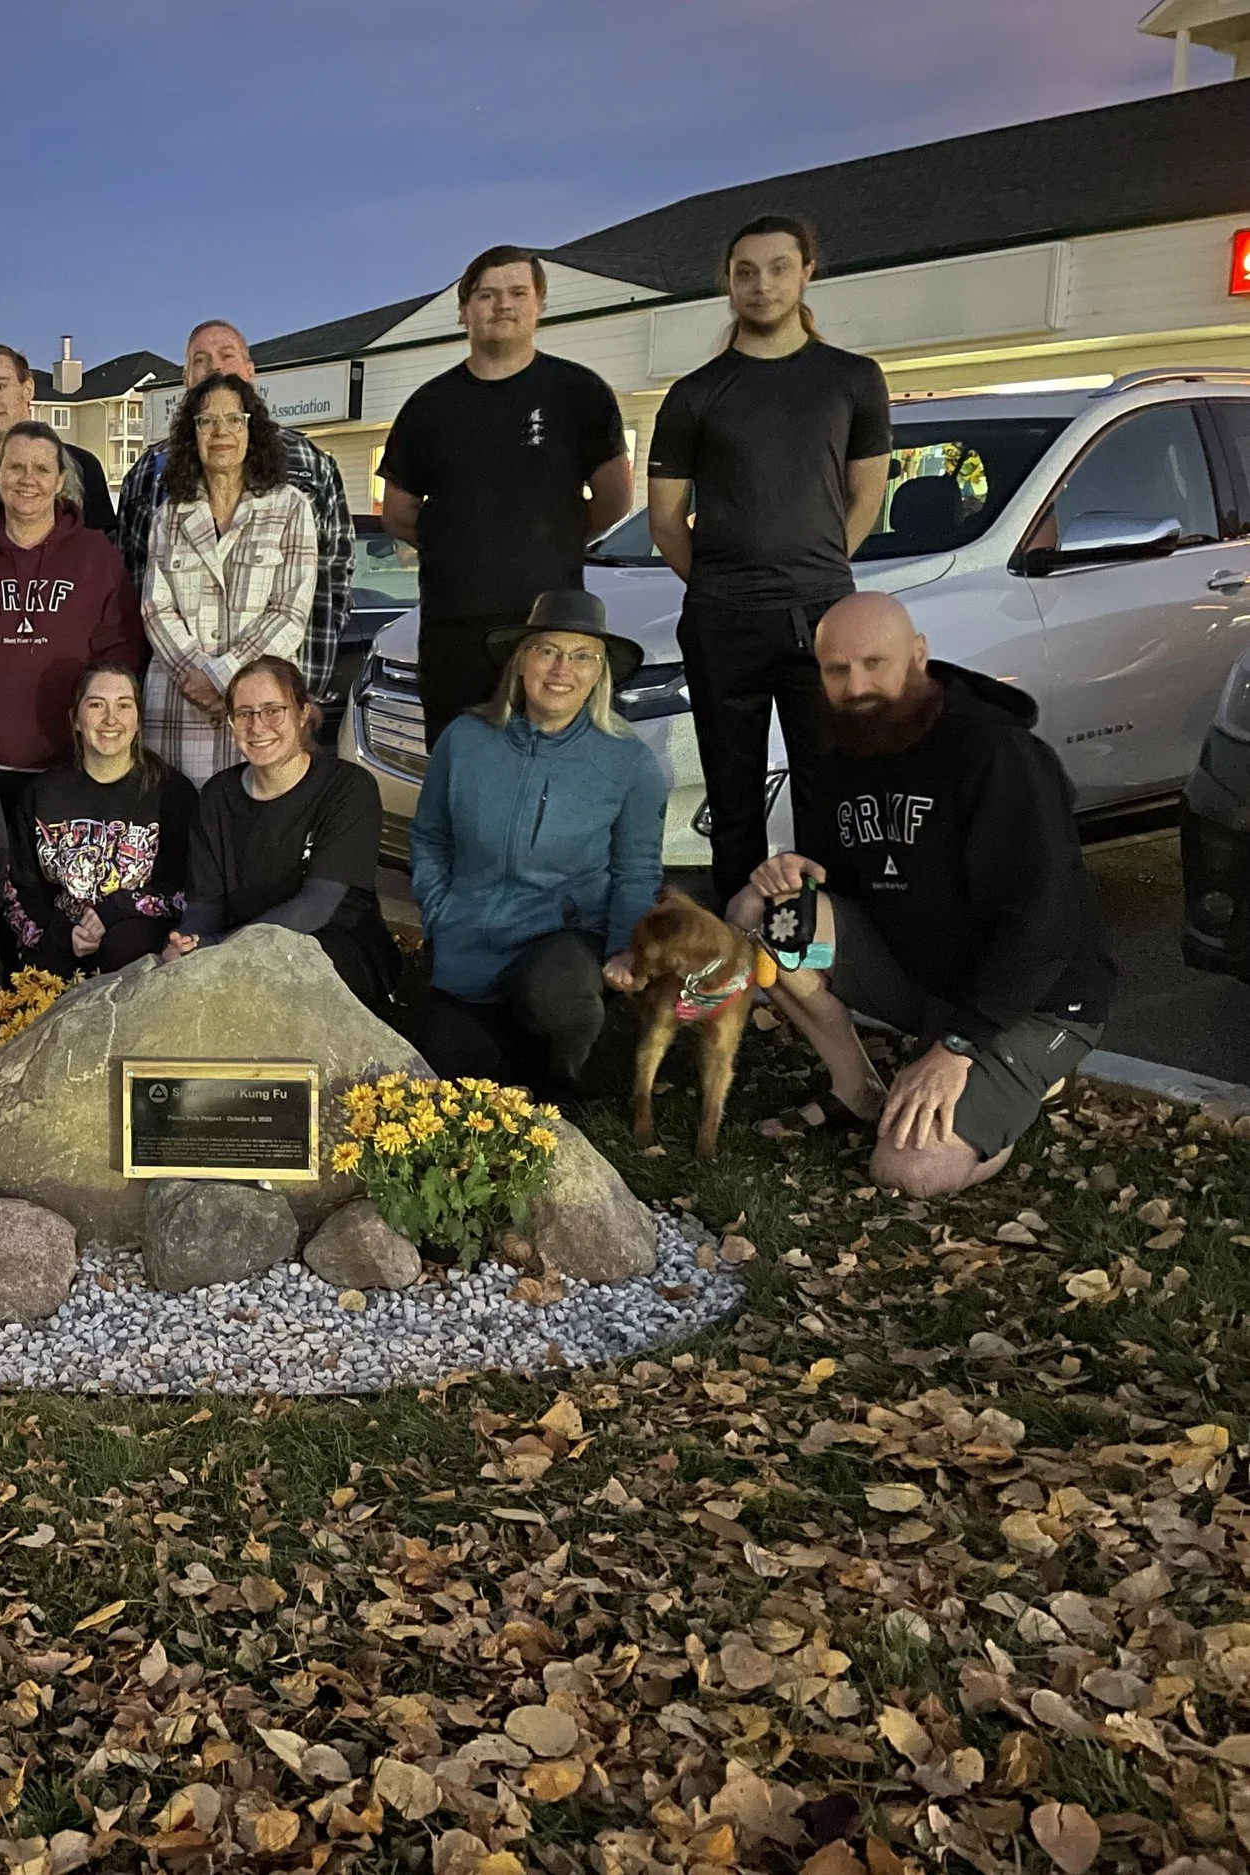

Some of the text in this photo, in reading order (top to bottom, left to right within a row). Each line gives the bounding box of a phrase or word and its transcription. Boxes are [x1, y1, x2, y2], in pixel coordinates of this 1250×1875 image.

[270, 398, 331, 418] Association
[837, 792, 934, 848] SRKF
[240, 1089, 270, 1100] Kung
[273, 1089, 288, 1099] Fu
